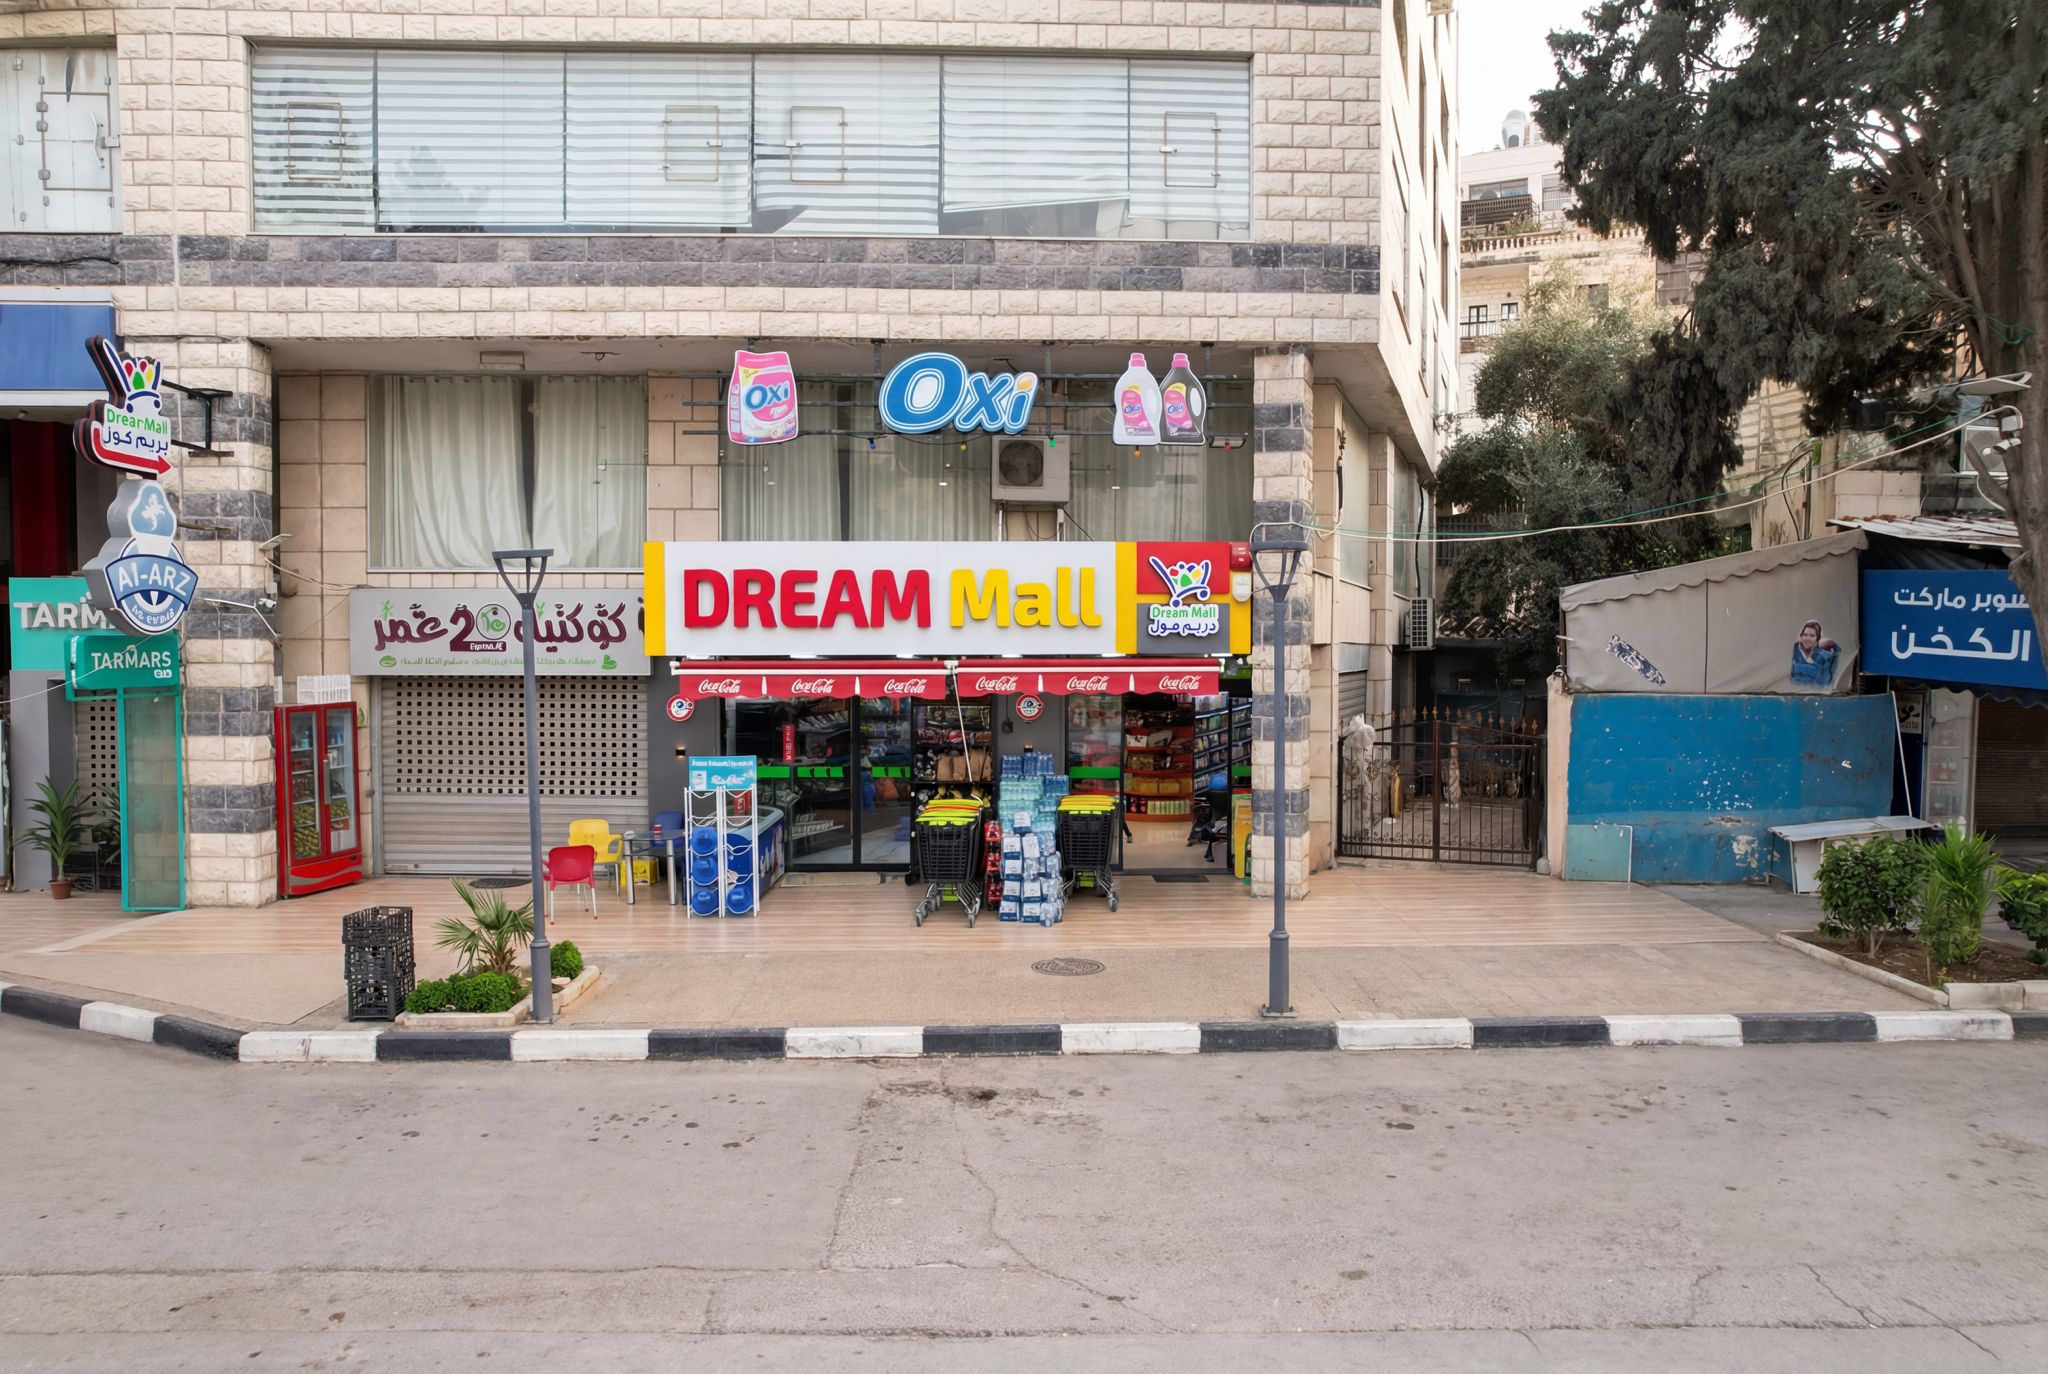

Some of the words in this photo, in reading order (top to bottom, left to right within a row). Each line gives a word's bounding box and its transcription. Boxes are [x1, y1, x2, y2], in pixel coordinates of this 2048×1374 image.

[683, 569, 931, 629] DREAM
[950, 567, 1103, 628] Mall
[1894, 587, 1966, 611] ماركت
[13, 601, 116, 629] TARM
[1152, 606, 1188, 618] Dream
[1191, 606, 1216, 618] Mall
[1151, 619, 1180, 633] مول
[1182, 622, 1216, 634] دريم
[91, 651, 172, 670] TARMARS
